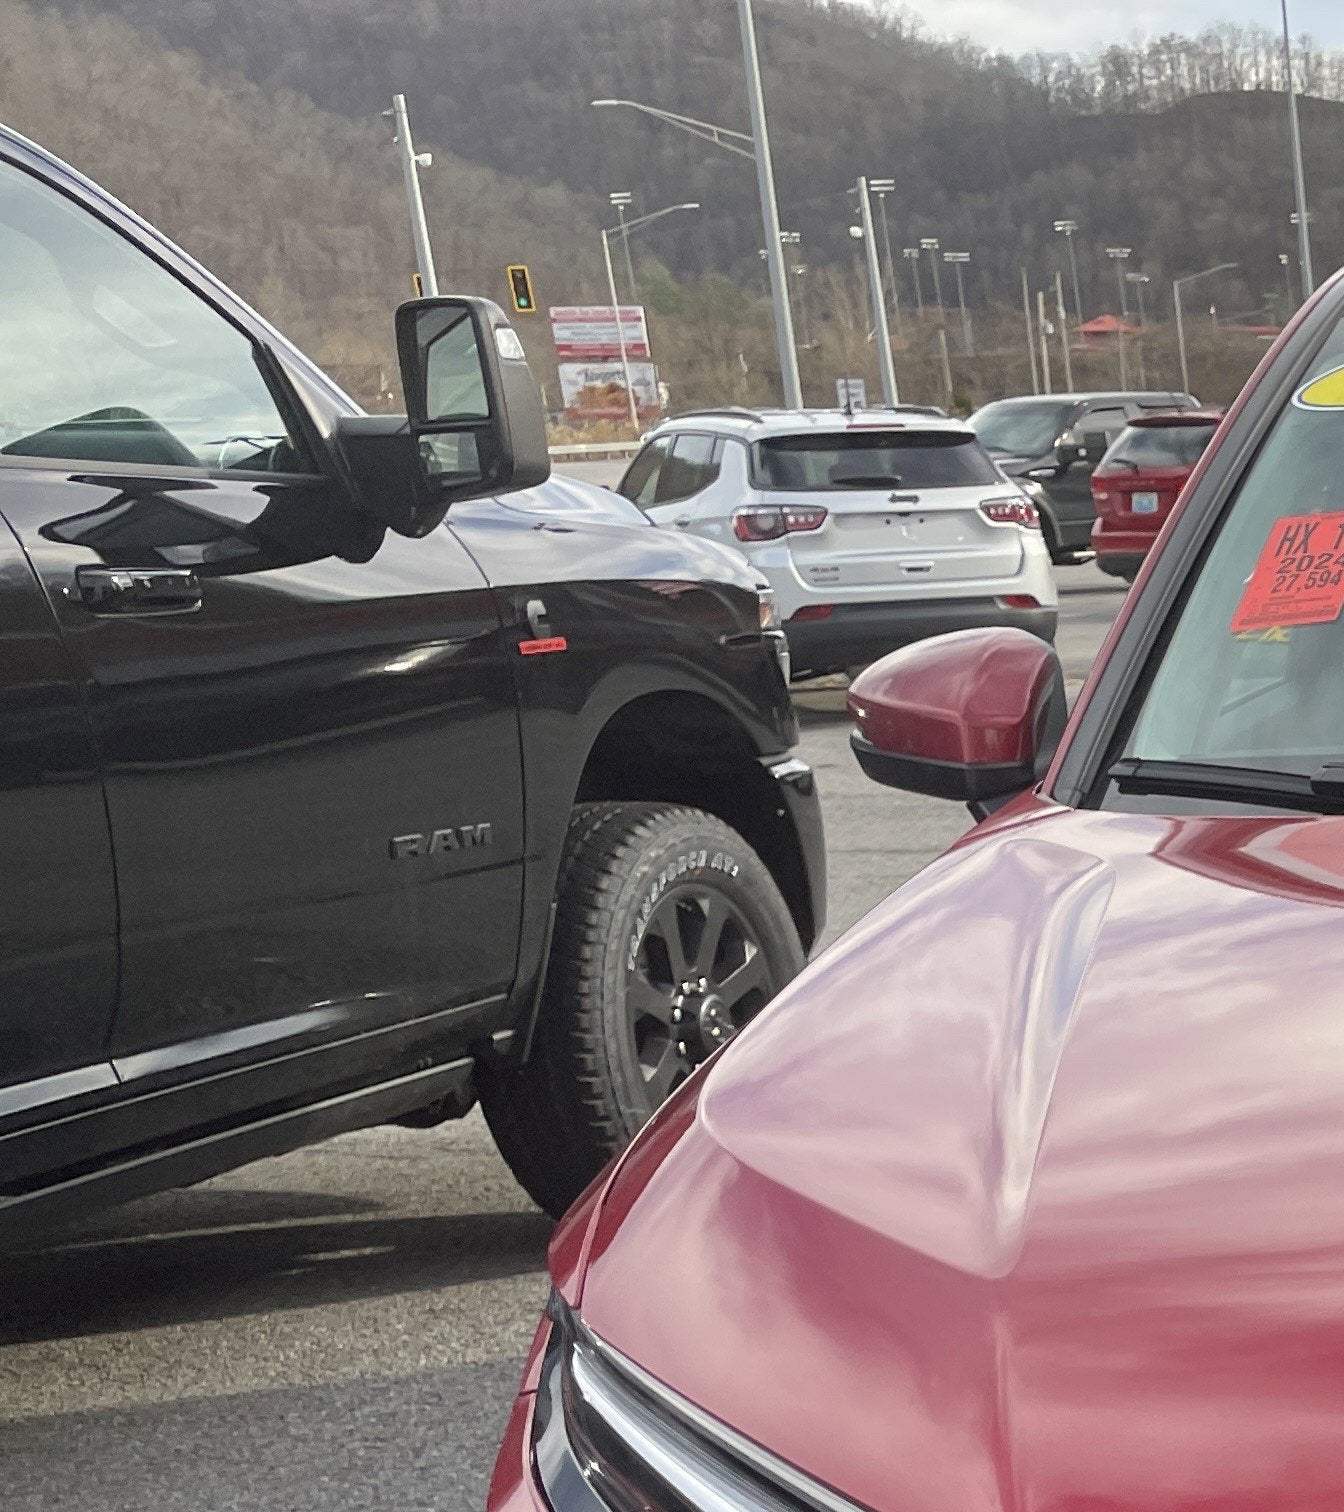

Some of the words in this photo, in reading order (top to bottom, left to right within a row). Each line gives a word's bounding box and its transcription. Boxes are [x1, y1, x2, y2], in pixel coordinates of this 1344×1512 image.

[1274, 521, 1320, 557] HX
[1270, 569, 1344, 594] 27,594
[388, 822, 493, 860] RAM
